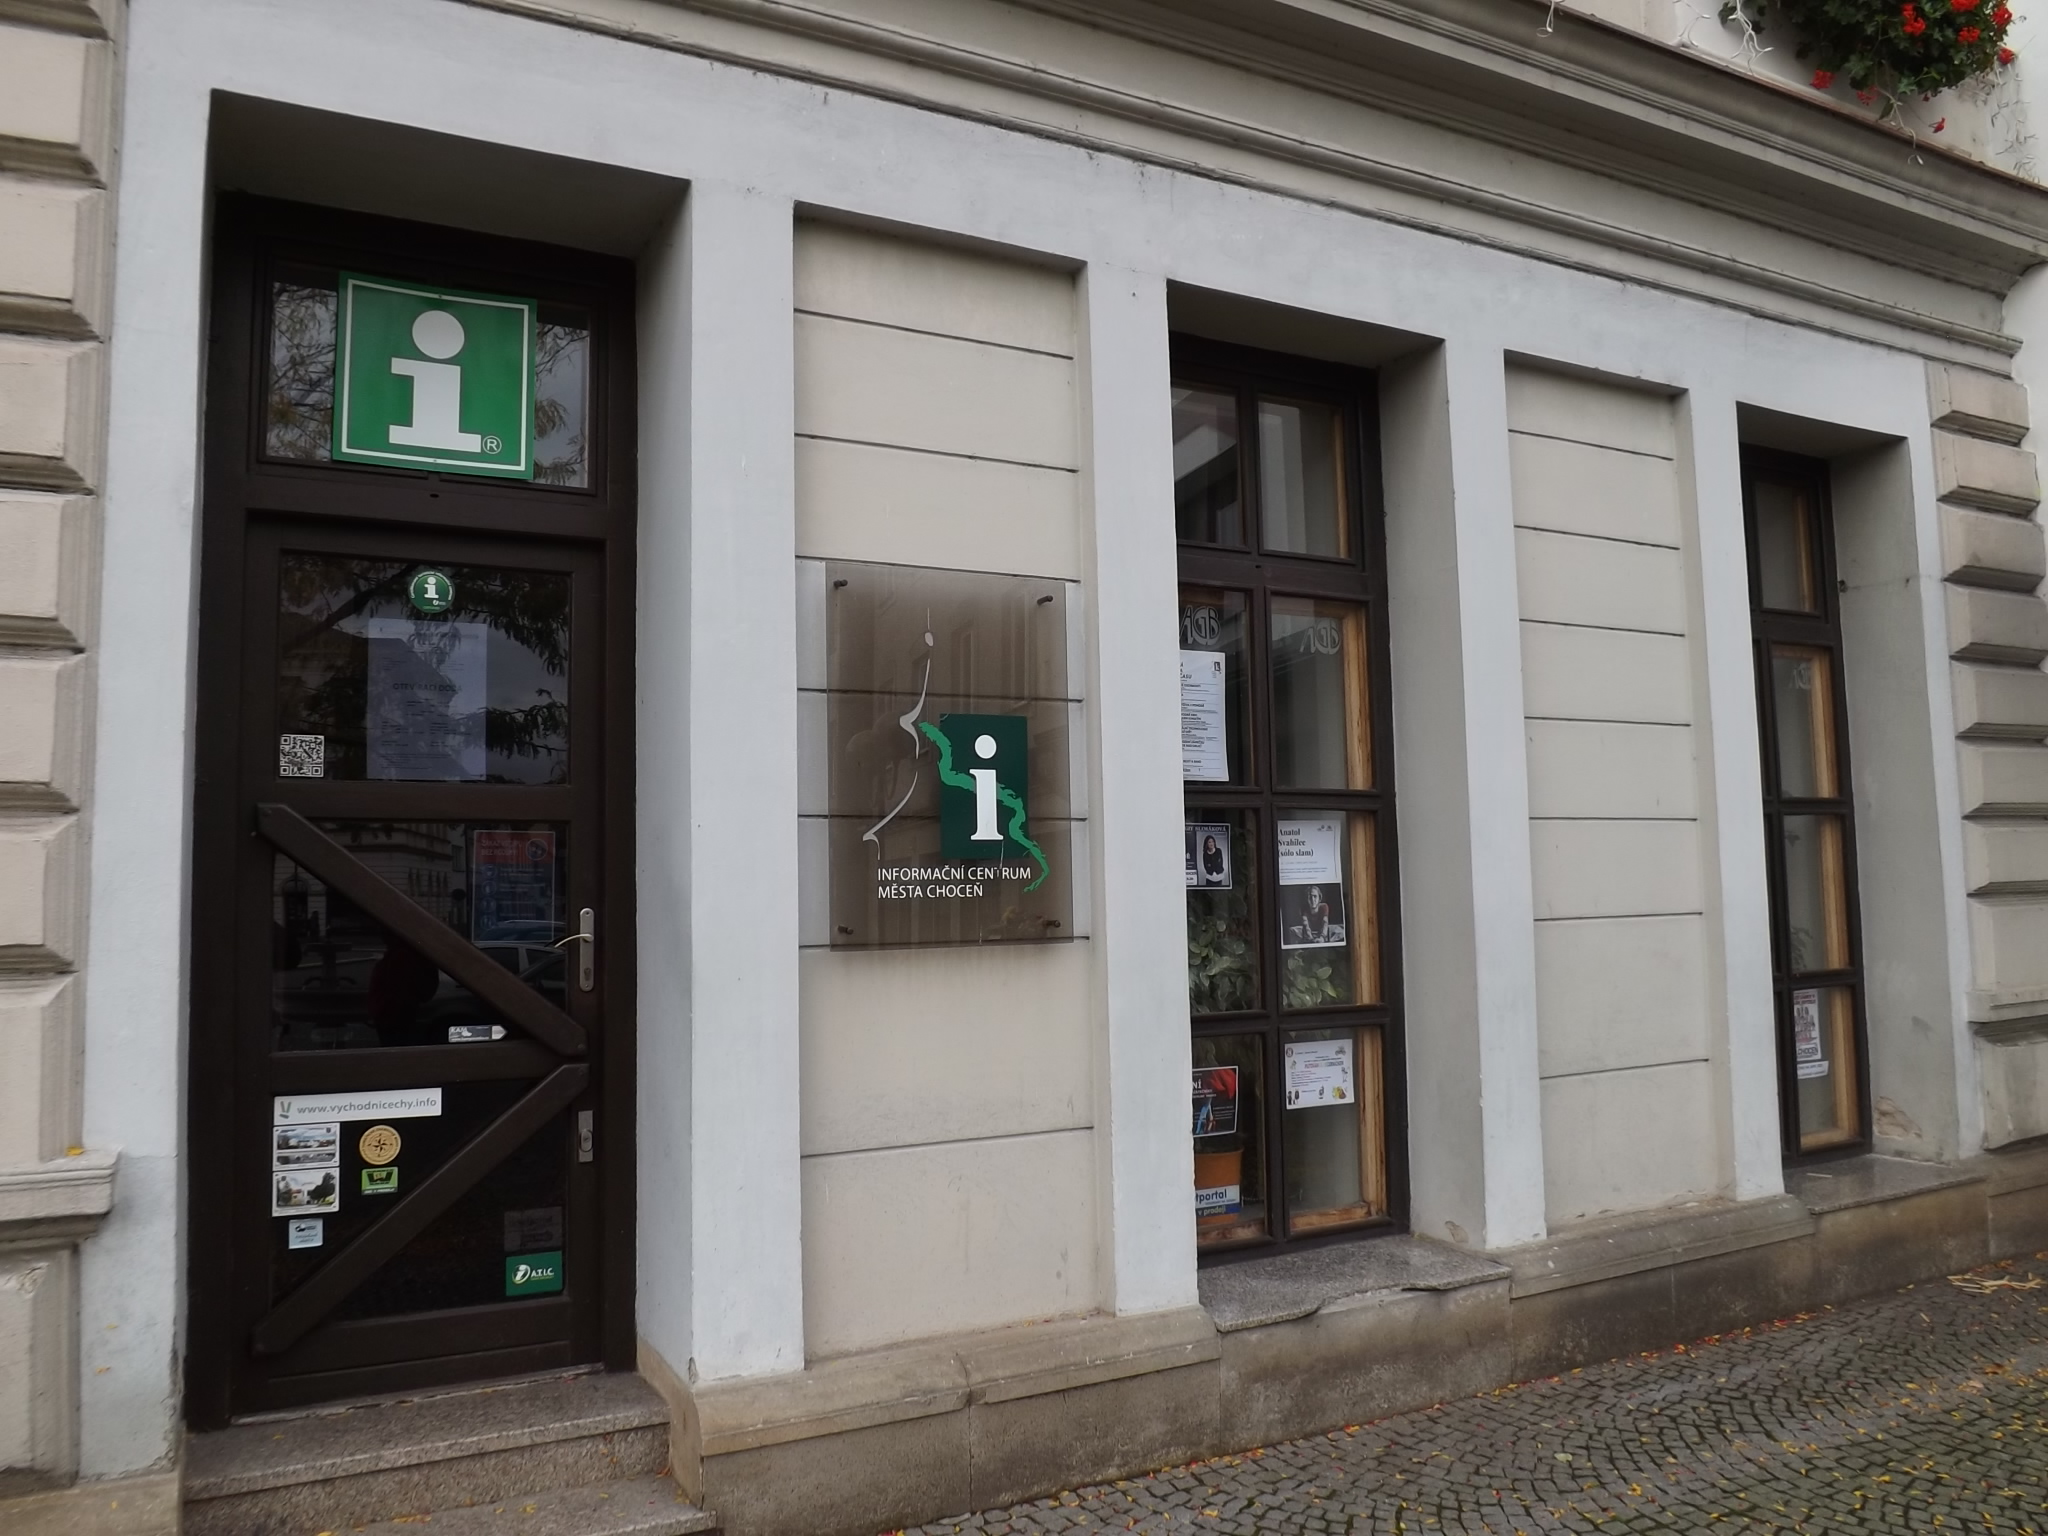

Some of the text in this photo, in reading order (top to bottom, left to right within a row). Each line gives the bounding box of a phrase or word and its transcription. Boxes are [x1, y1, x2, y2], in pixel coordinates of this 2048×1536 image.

[877, 865, 965, 881] INFORMAČNÍ
[877, 882, 984, 899] MĚSTA CHOCEŇ
[296, 1097, 437, 1115] www.vychodnicechy.info
